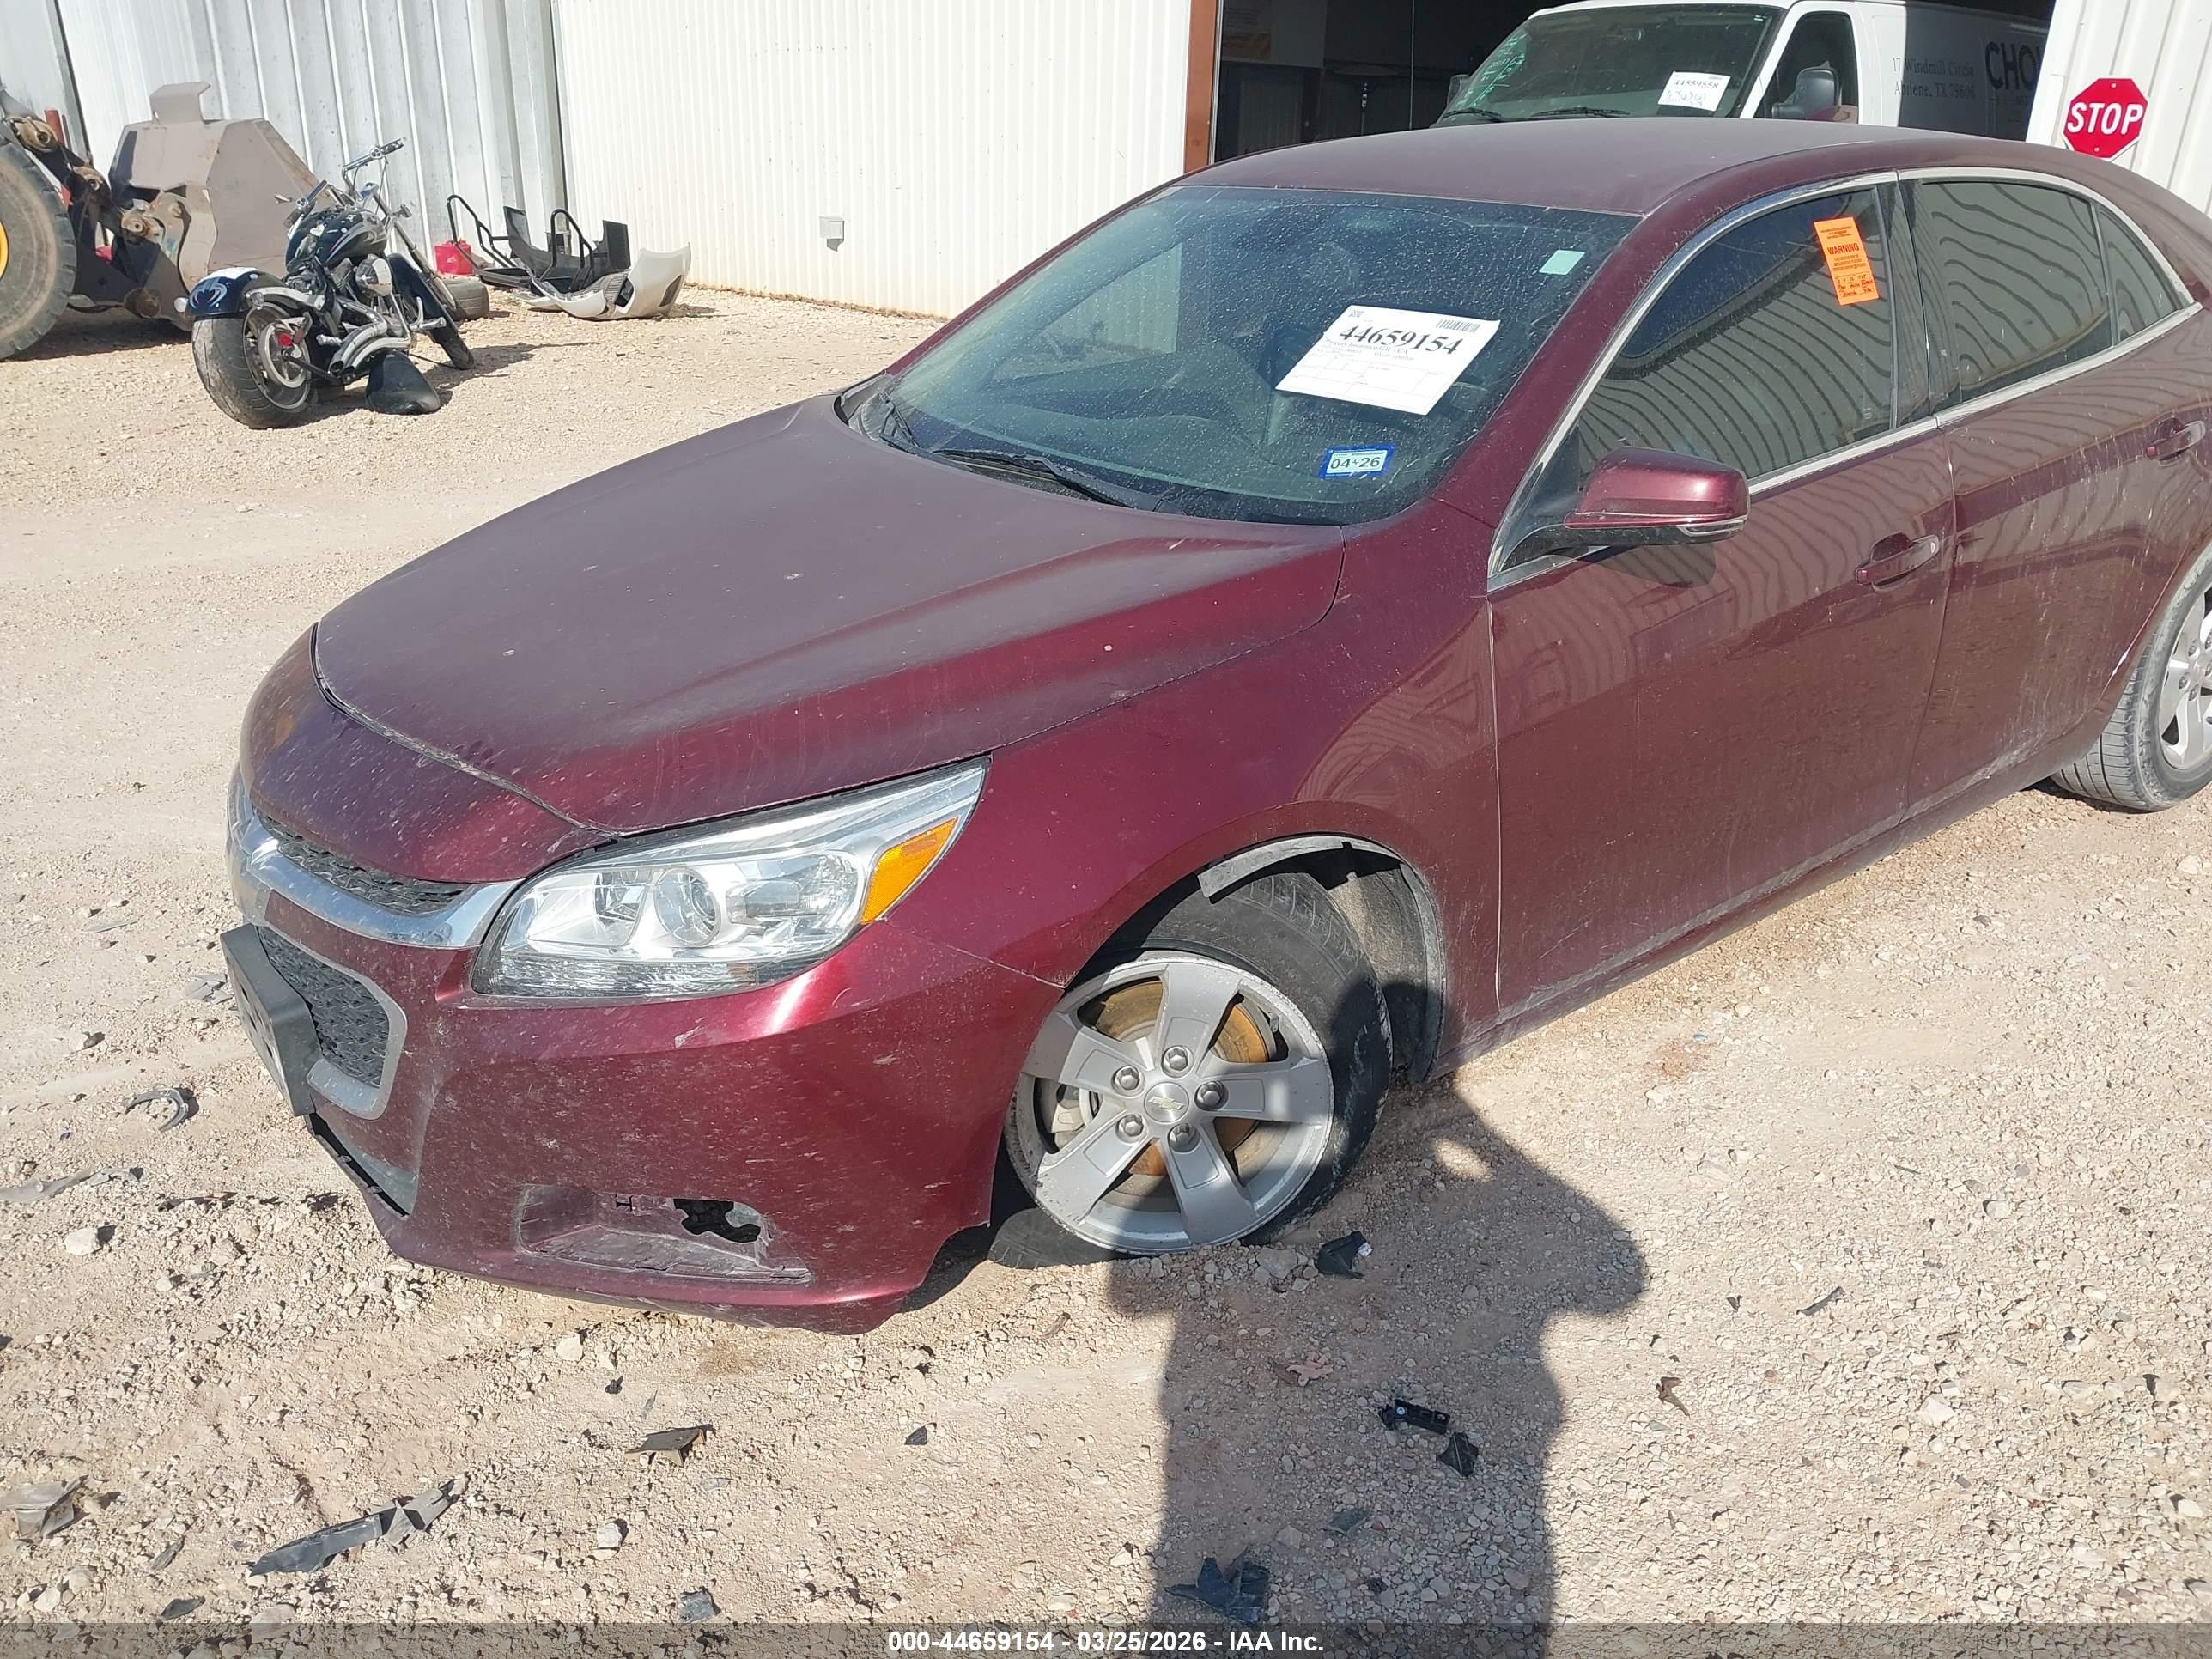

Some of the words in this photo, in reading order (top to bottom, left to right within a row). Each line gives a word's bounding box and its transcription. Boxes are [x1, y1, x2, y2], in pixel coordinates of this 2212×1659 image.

[1892, 58, 1901, 72] 17
[1903, 57, 1946, 76] Windmill
[1948, 61, 1975, 76] Circle
[1894, 80, 1933, 97] Abilene,
[1936, 82, 1948, 97] TX
[2067, 102, 2144, 136] STOP
[1826, 242, 1860, 255] WARNING
[1340, 325, 1464, 355] 44659154
